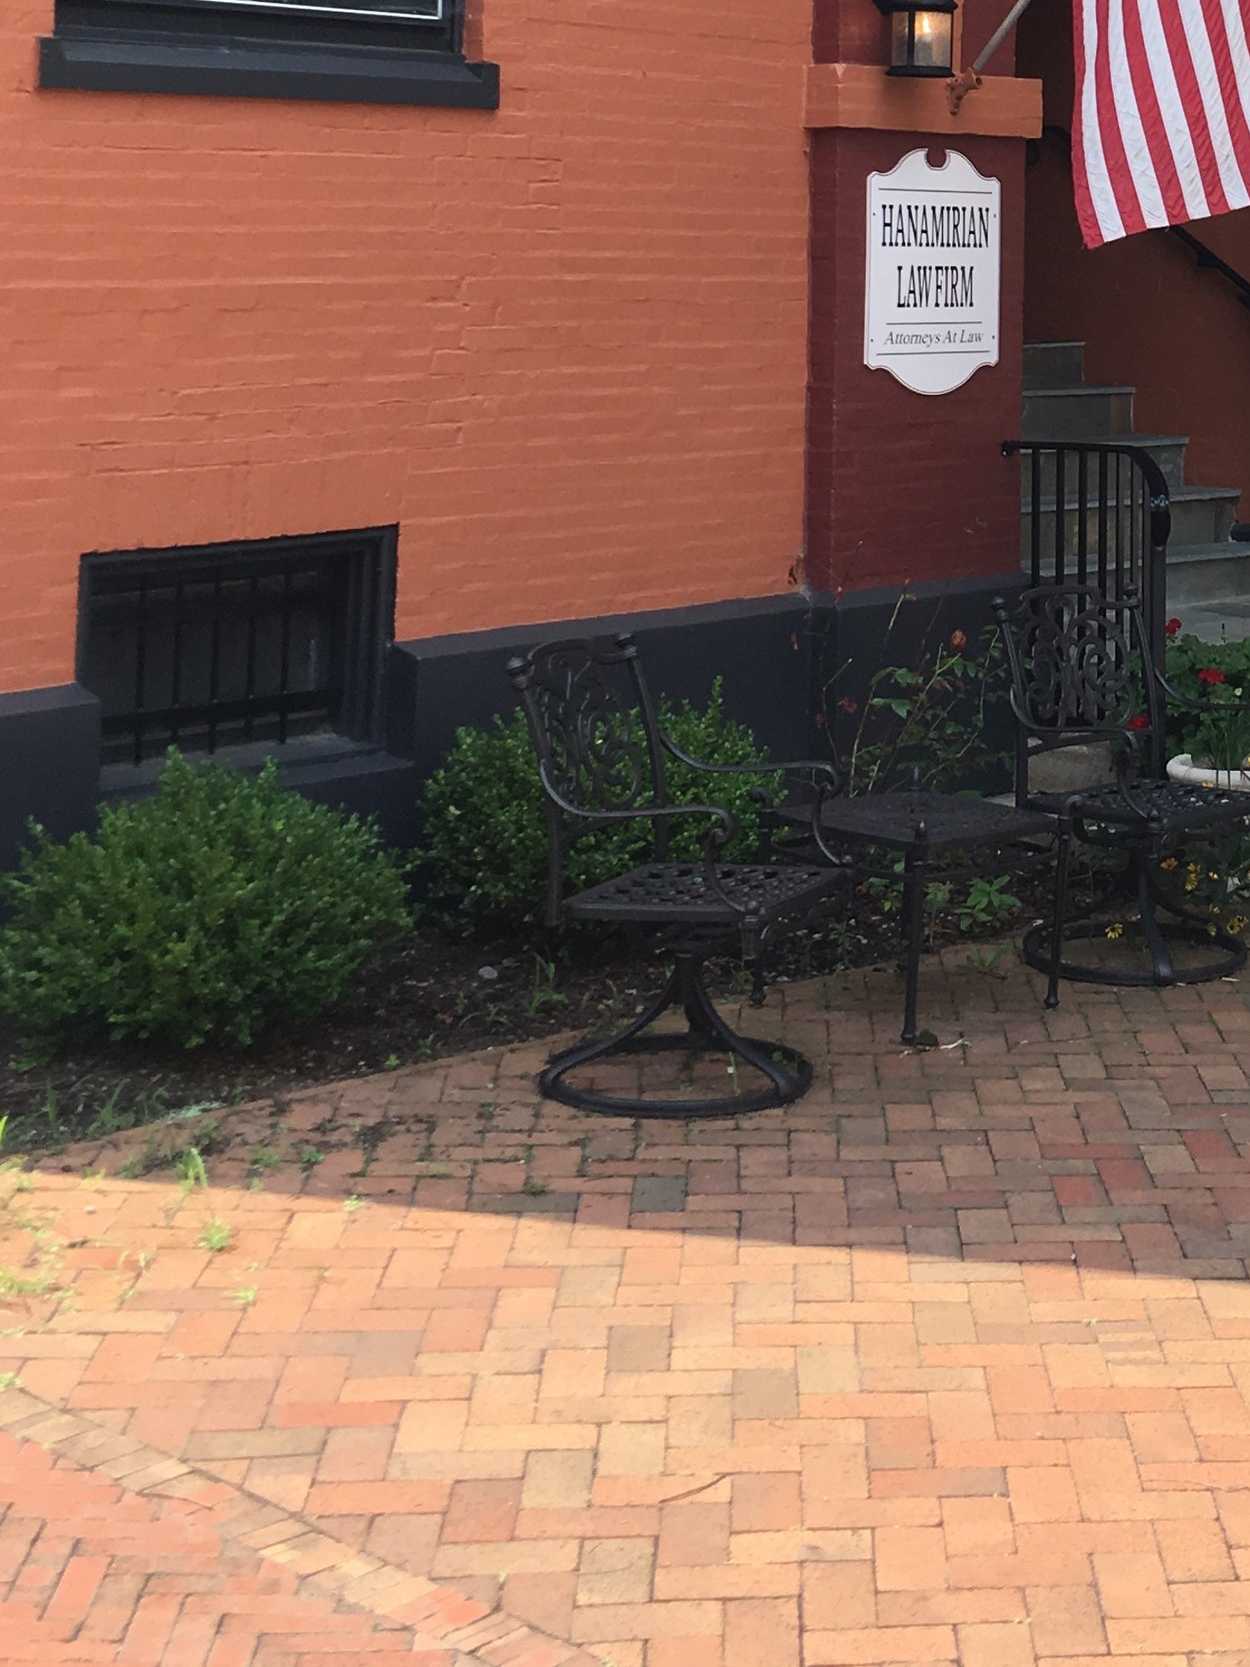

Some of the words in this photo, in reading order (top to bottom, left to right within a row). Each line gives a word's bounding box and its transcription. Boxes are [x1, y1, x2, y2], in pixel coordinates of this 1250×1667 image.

[881, 203, 990, 248] HANAMIRIAN
[897, 265, 933, 308] LAW
[934, 265, 975, 308] FIRM
[884, 330, 941, 348] Attorneys
[943, 330, 959, 344] At
[960, 328, 985, 344] Law
